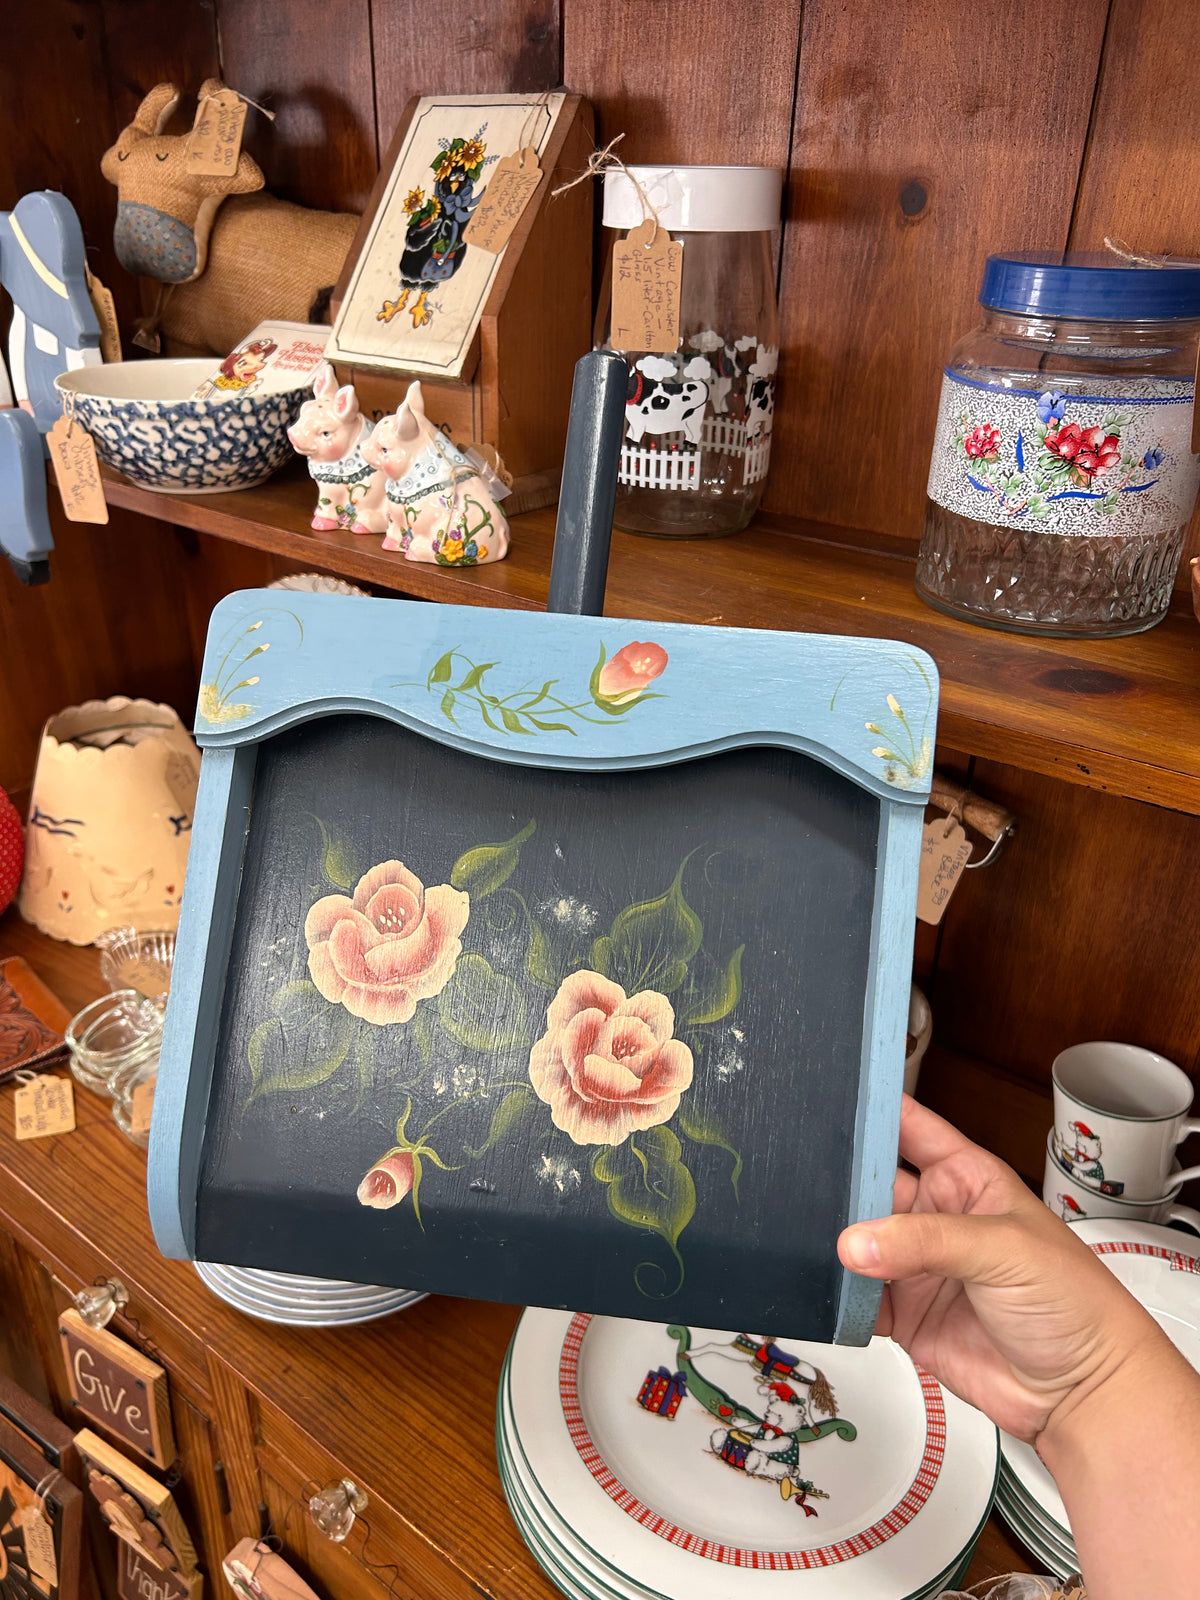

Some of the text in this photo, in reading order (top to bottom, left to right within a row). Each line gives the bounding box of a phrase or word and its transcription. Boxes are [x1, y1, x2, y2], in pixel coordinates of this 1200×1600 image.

[498, 171, 520, 207] Holder
[501, 173, 531, 216] Wooden
[509, 175, 538, 219] Vintage
[478, 205, 493, 226] $22
[616, 255, 632, 281] $12
[632, 249, 642, 283] Glass
[643, 257, 653, 273] 1.5
[652, 258, 665, 313] Vintage
[666, 247, 681, 337] Cow Canister
[618, 328, 630, 338] L
[932, 845, 968, 905] Vintage Egg
[74, 1348, 150, 1434] Give
